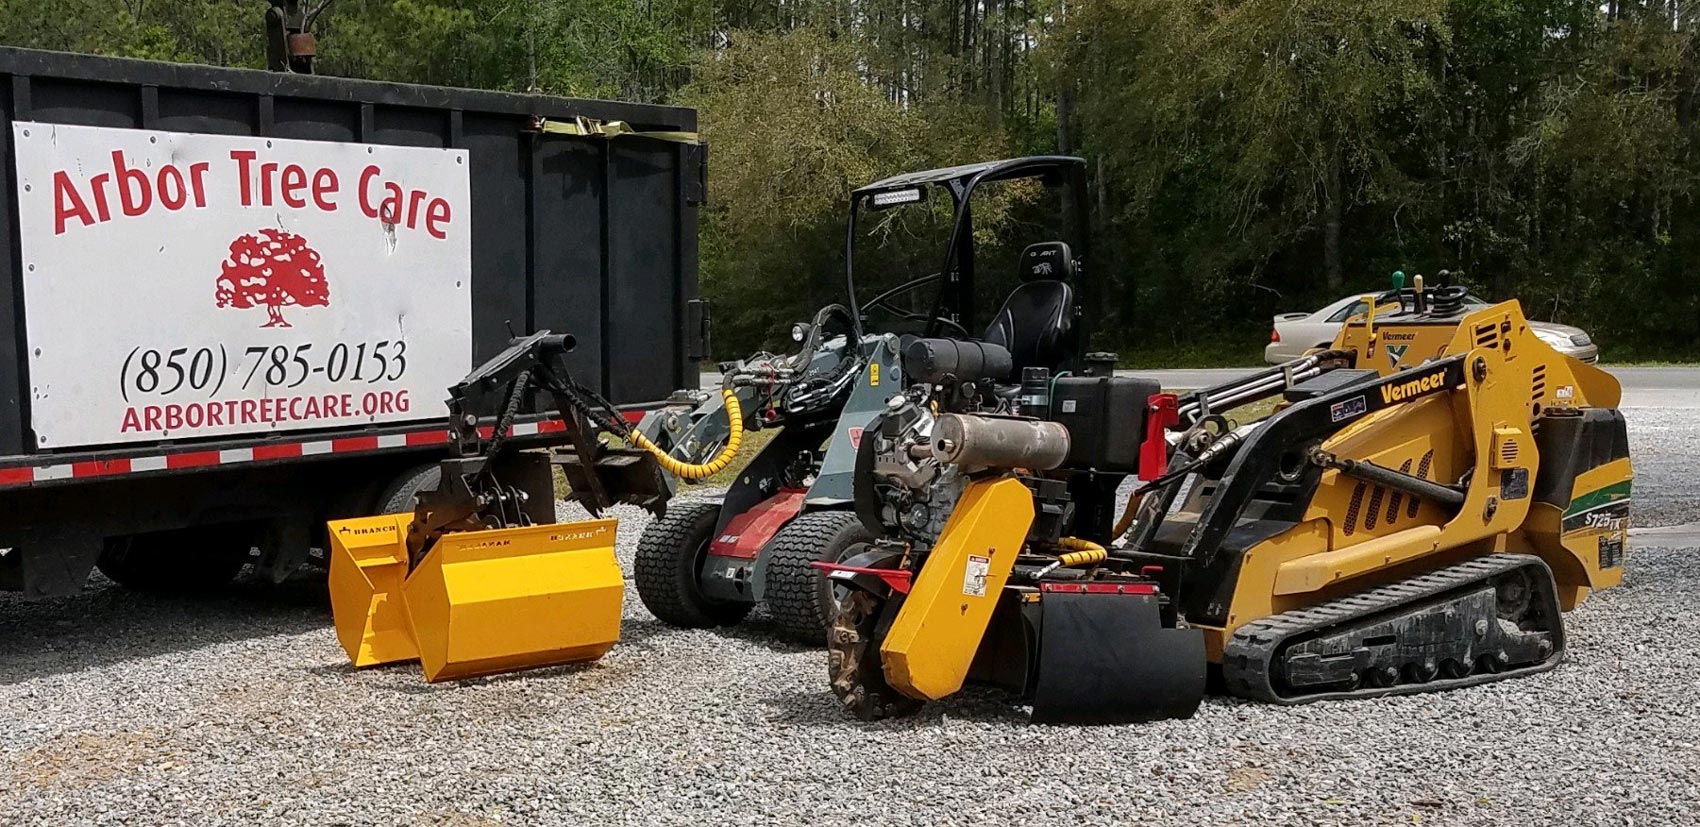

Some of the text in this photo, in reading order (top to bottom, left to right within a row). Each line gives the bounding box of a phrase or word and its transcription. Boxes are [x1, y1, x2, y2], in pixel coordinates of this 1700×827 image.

[53, 150, 452, 239] Arbor Tree Care
[1382, 331, 1416, 341] Vermeer
[120, 341, 408, 402] (850) 785-0153
[1381, 371, 1446, 404] Vermeer
[121, 390, 410, 433] ARBORTREECARE.ORG
[354, 525, 395, 535] BRANCH
